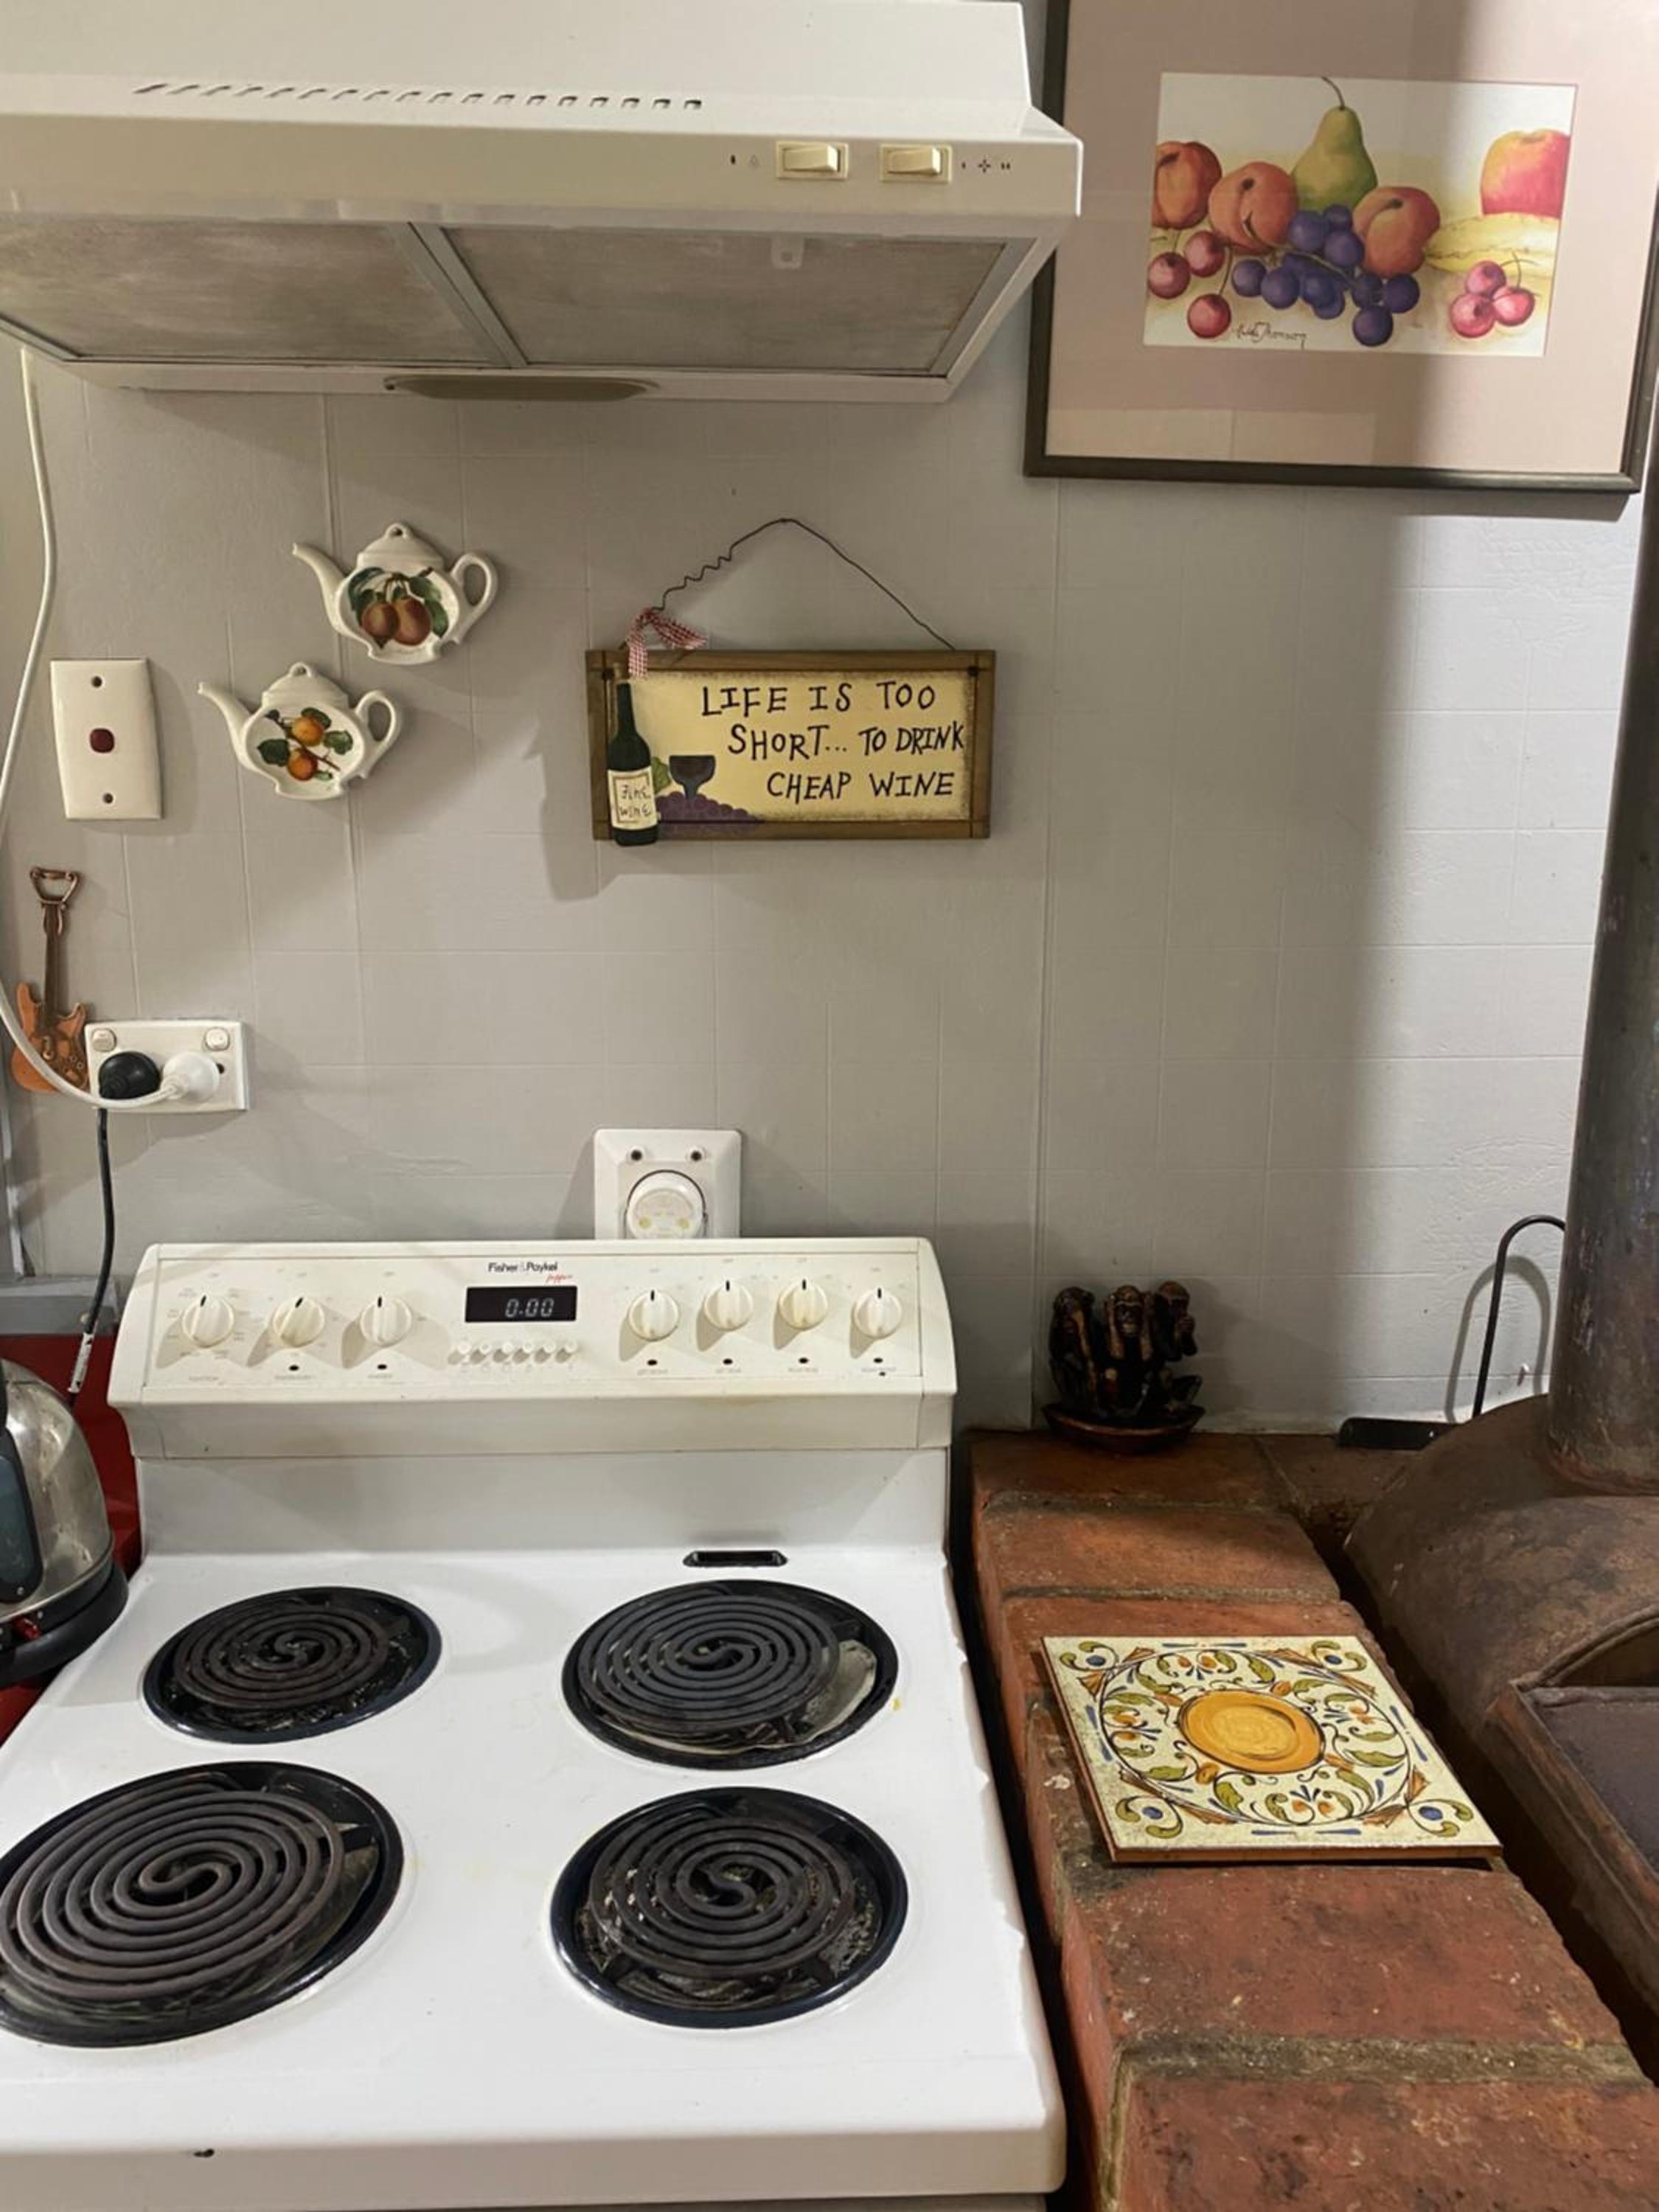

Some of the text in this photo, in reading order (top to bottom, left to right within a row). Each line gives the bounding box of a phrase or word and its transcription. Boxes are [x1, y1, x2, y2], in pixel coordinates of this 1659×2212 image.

[701, 681, 936, 717] LIFE IS TOO
[858, 726, 887, 756] TO
[895, 720, 964, 755] DRINK
[766, 771, 955, 804] CHEAP WINE
[488, 1262, 518, 1273] Fisher
